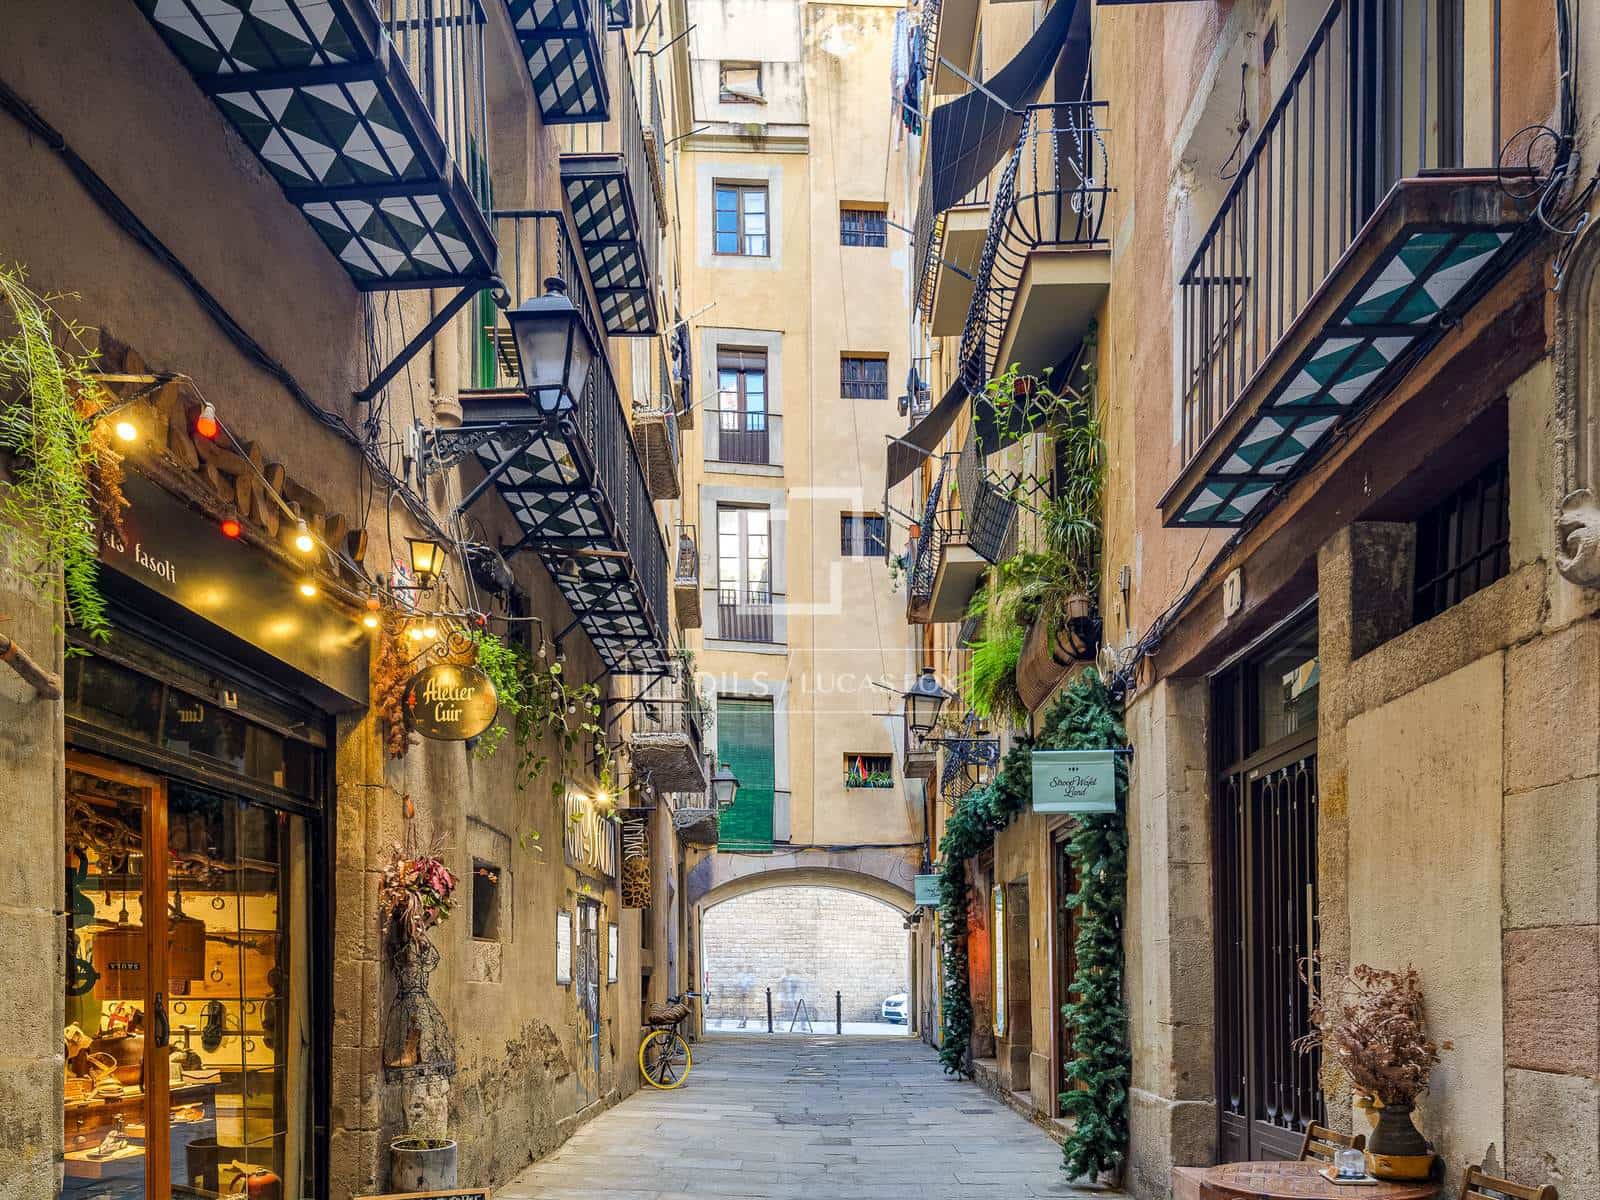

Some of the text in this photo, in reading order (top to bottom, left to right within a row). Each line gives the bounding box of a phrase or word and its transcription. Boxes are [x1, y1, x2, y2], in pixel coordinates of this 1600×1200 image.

[134, 543, 177, 585] fasoli
[422, 677, 476, 704] Atelier
[434, 701, 463, 722] Cuir
